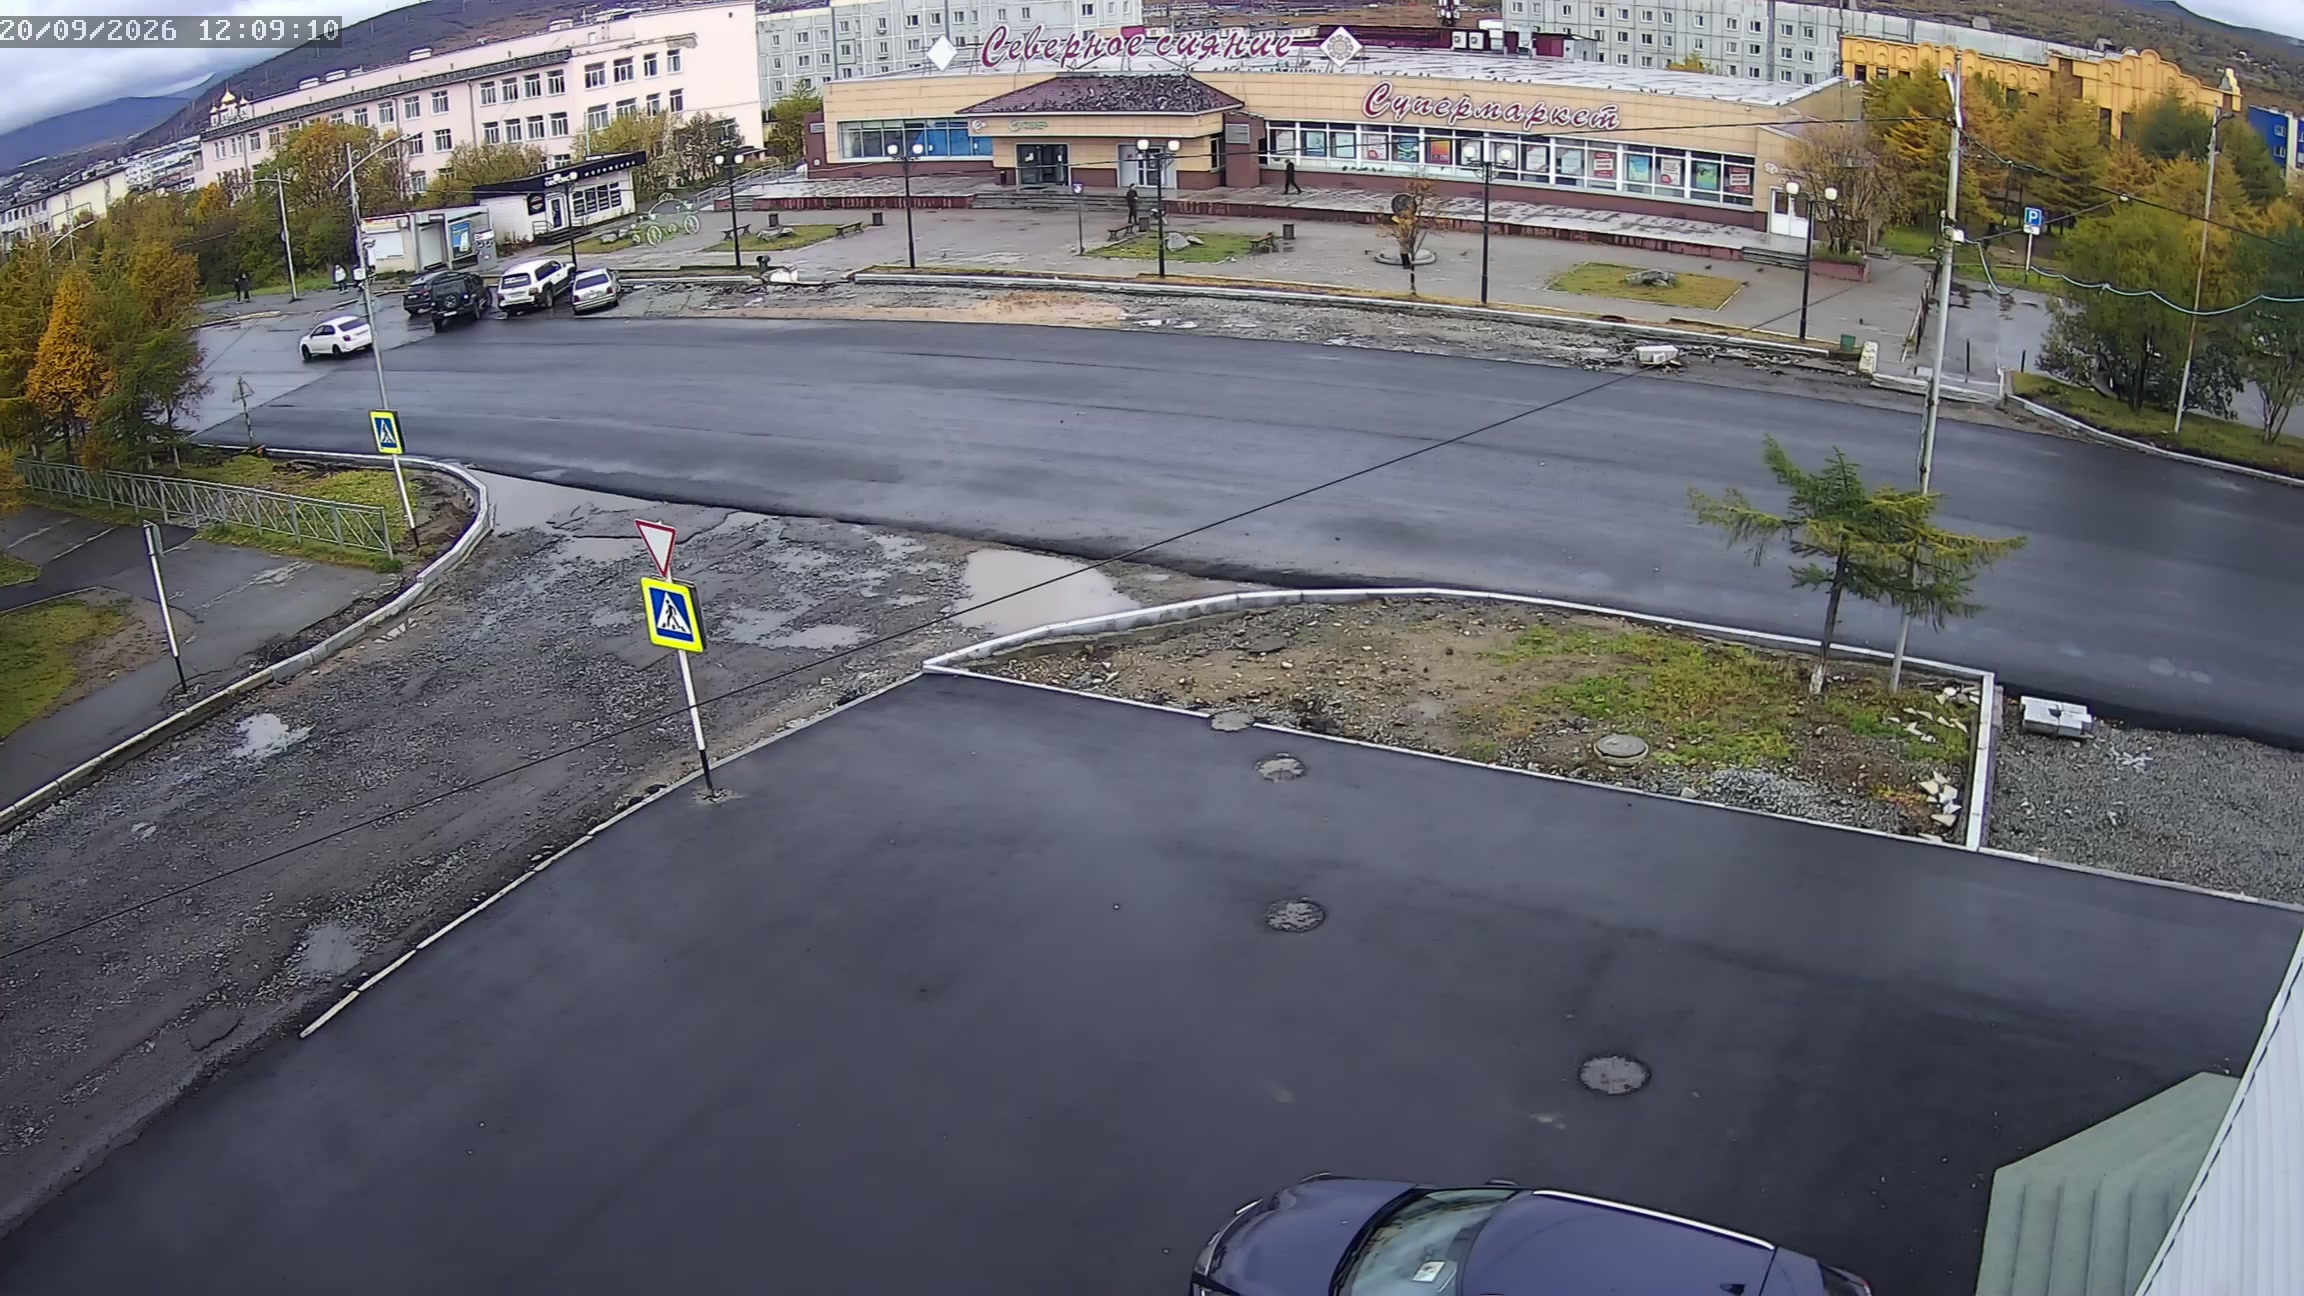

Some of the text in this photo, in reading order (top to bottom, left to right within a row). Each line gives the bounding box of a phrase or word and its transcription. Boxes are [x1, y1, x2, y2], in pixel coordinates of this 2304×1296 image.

[982, 24, 1294, 70] Северное сияние
[1362, 80, 1621, 129] Супермаркет
